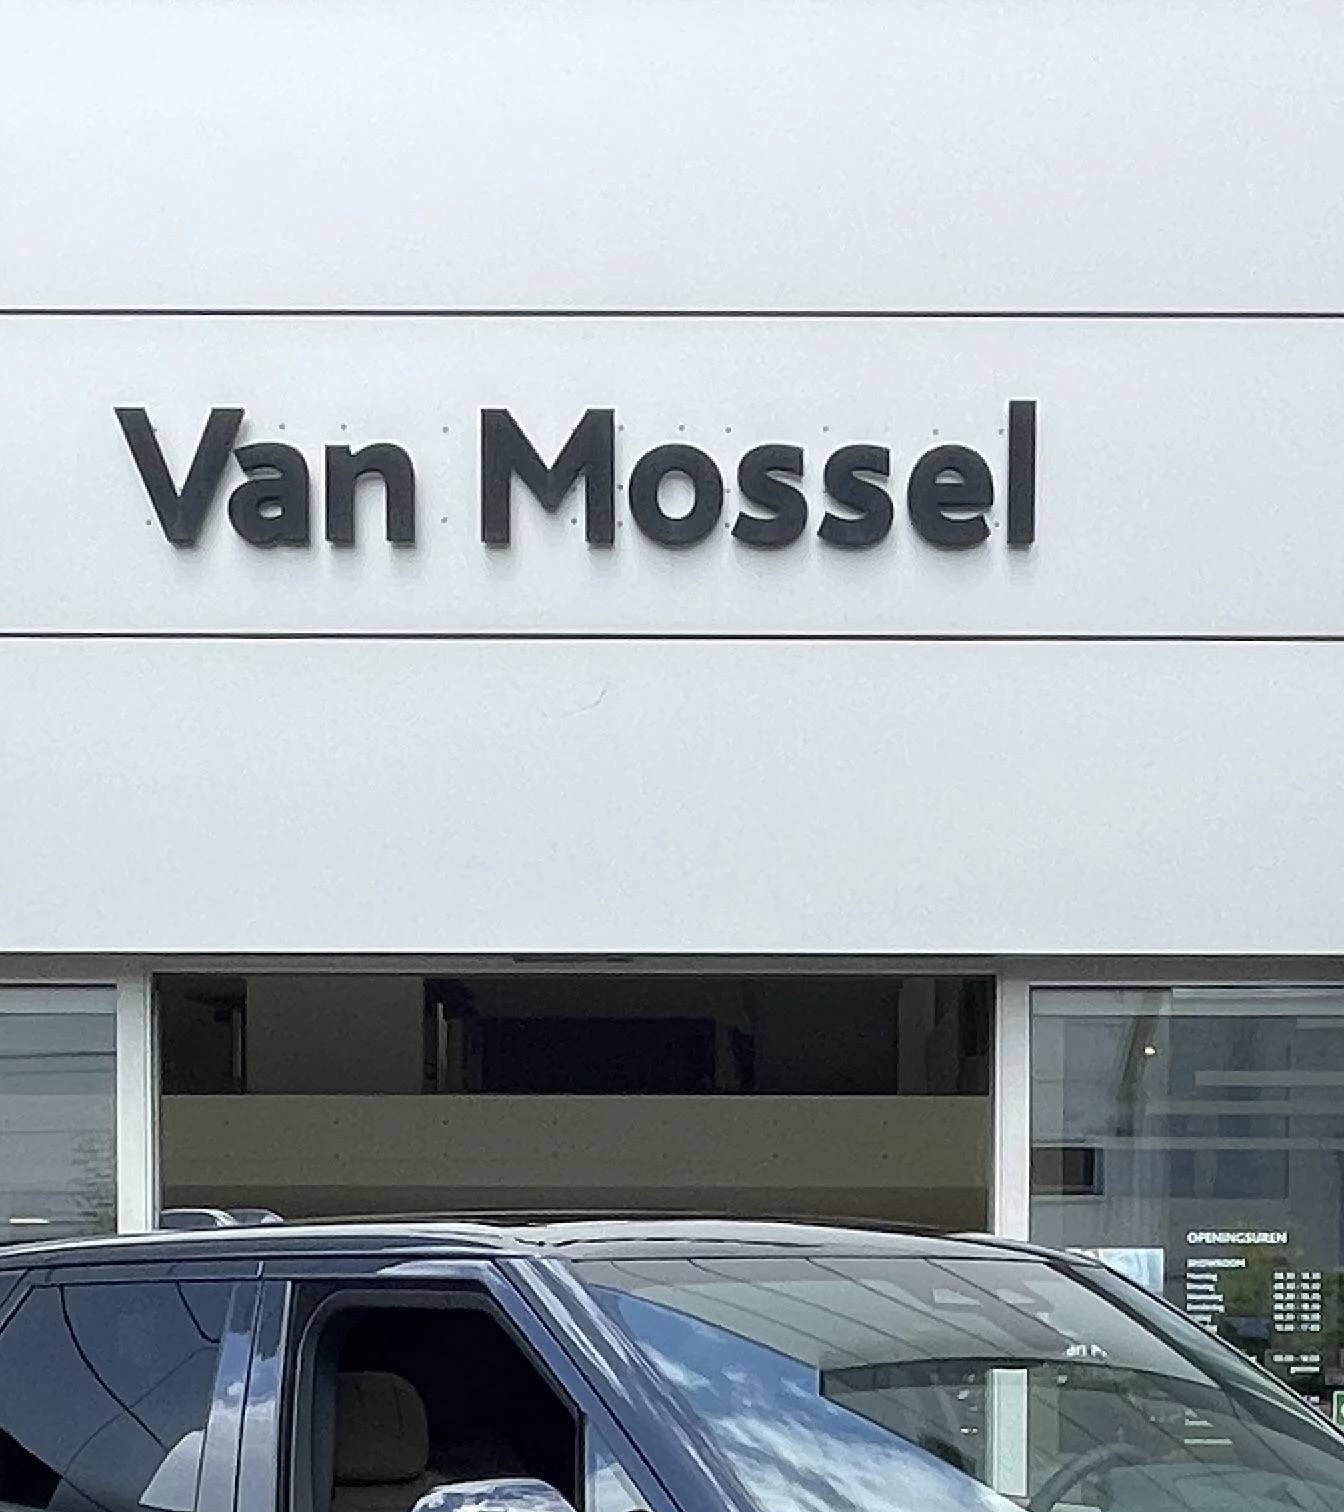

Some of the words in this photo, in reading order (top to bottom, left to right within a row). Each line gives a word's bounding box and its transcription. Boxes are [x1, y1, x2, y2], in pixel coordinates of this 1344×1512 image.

[113, 405, 418, 549] Van
[480, 399, 1038, 549] Mossel
[1186, 1231, 1289, 1244] OPENINGSUREN
